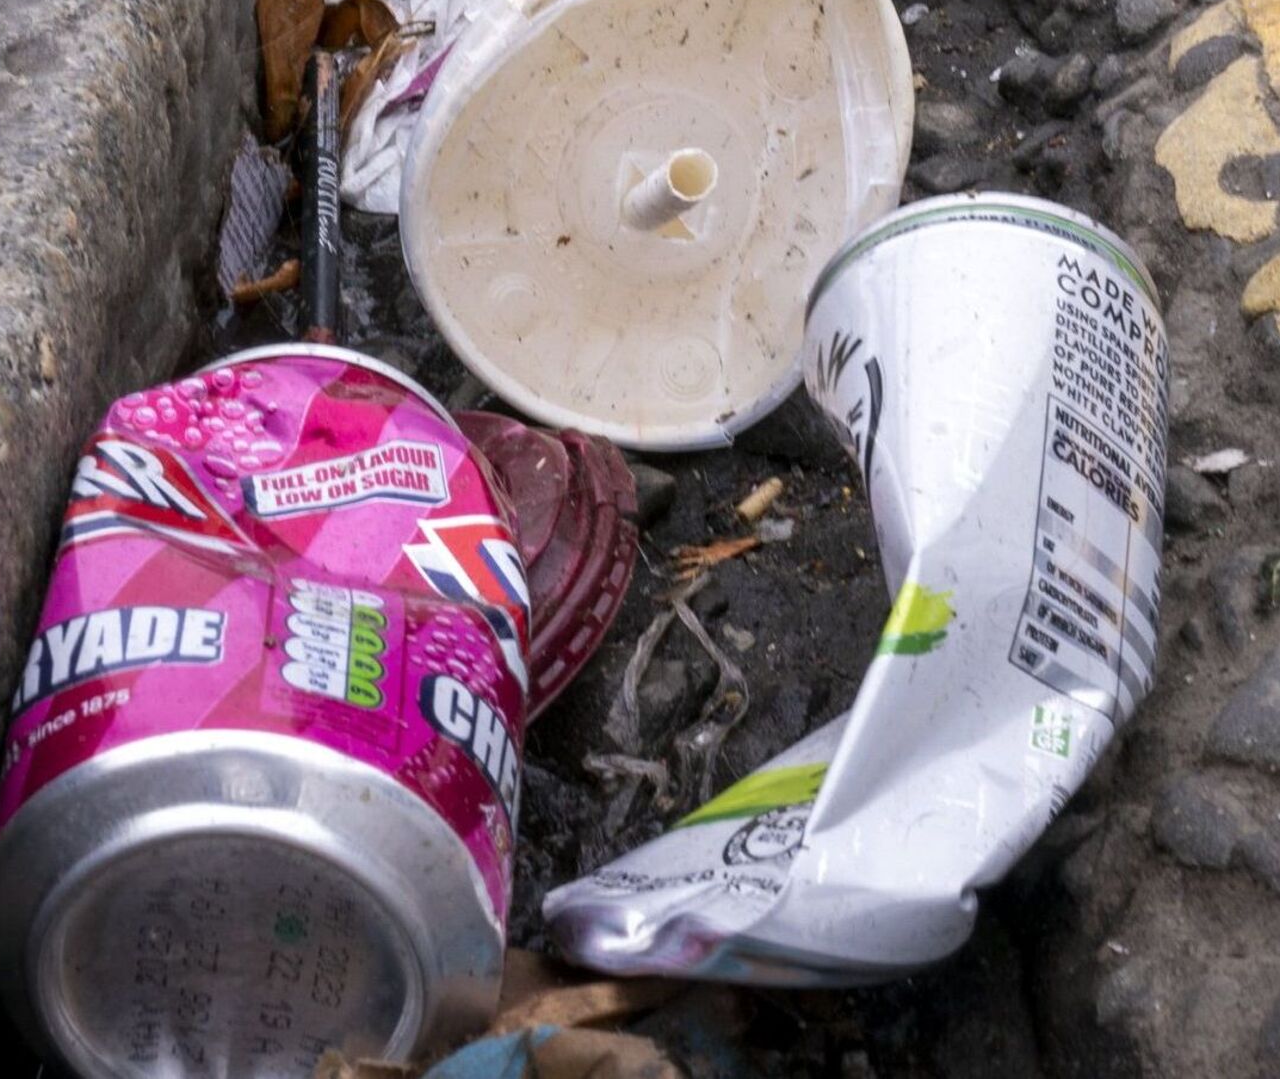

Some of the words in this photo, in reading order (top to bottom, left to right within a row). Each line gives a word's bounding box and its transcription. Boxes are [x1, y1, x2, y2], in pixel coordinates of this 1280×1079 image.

[1058, 254, 1134, 314] MADE
[1055, 328, 1121, 384] FLAVOURS
[1125, 378, 1139, 400] TO
[1056, 313, 1121, 366] DISTILLED
[1057, 298, 1098, 331] USING
[1102, 324, 1155, 387] SPARKLING
[1053, 359, 1112, 411] NOTHING
[1054, 344, 1075, 364] OF
[1080, 360, 1115, 397] PURE
[1052, 375, 1098, 418] WHITE
[1102, 411, 1134, 448] CLAW
[348, 445, 437, 477] FLAVOUR
[1055, 404, 1131, 480] NUTRITIONAL
[274, 490, 321, 507] LOW
[327, 481, 357, 500] ON
[361, 467, 430, 492] SUGAR
[1053, 440, 1139, 522] CALORIES
[27, 709, 76, 748] since
[79, 688, 131, 718] 1875
